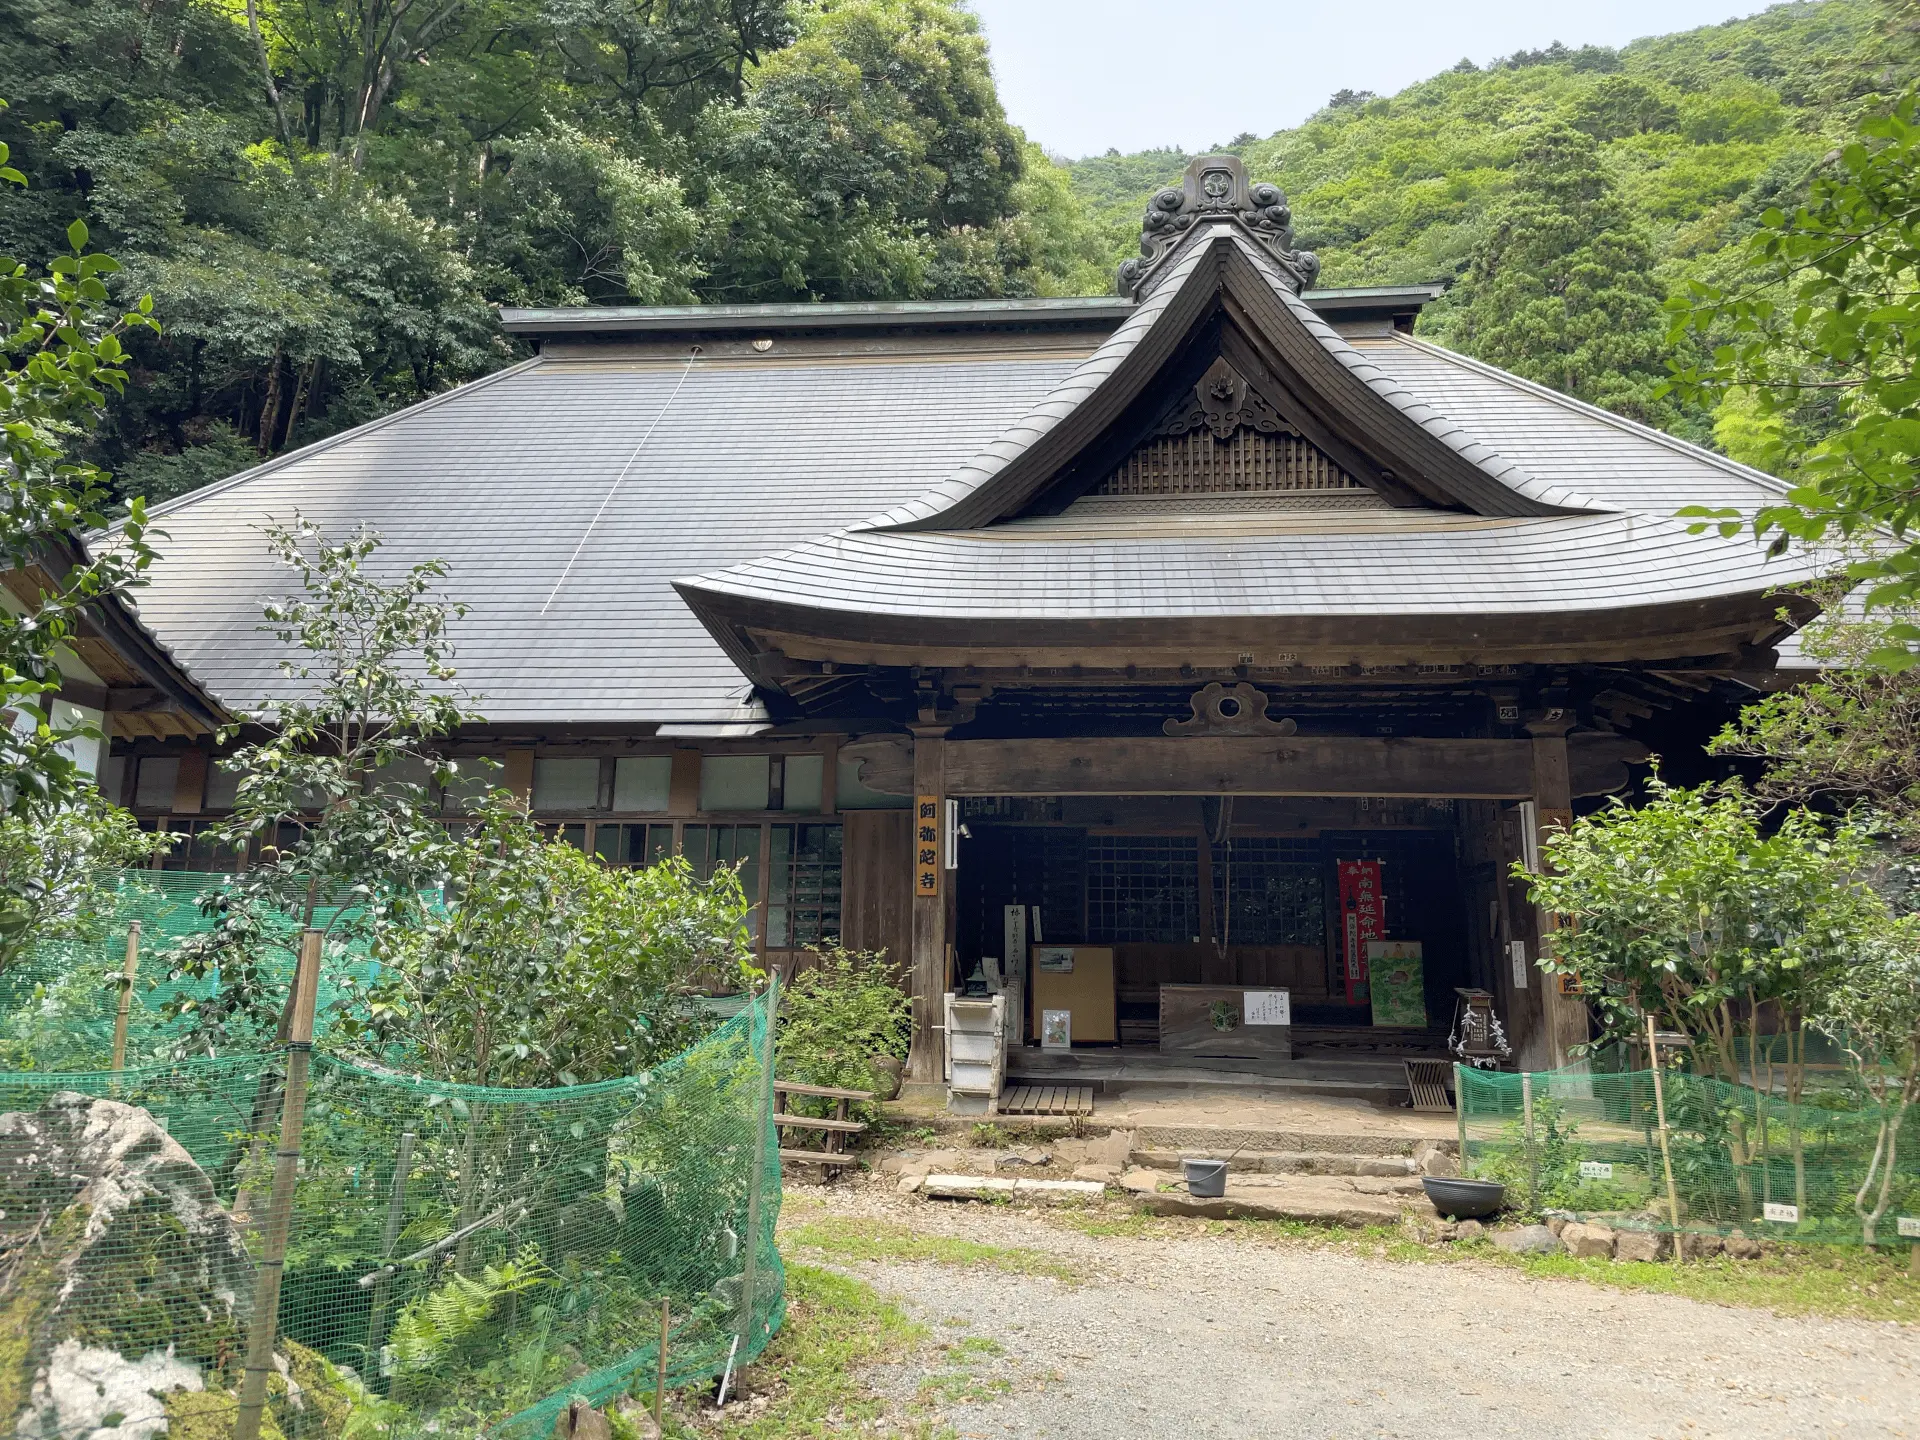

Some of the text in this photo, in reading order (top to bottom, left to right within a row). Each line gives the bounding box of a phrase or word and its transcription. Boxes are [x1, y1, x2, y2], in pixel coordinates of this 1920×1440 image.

[919, 802, 937, 889] 阿弥陀寺
[1346, 866, 1373, 877] 奉納
